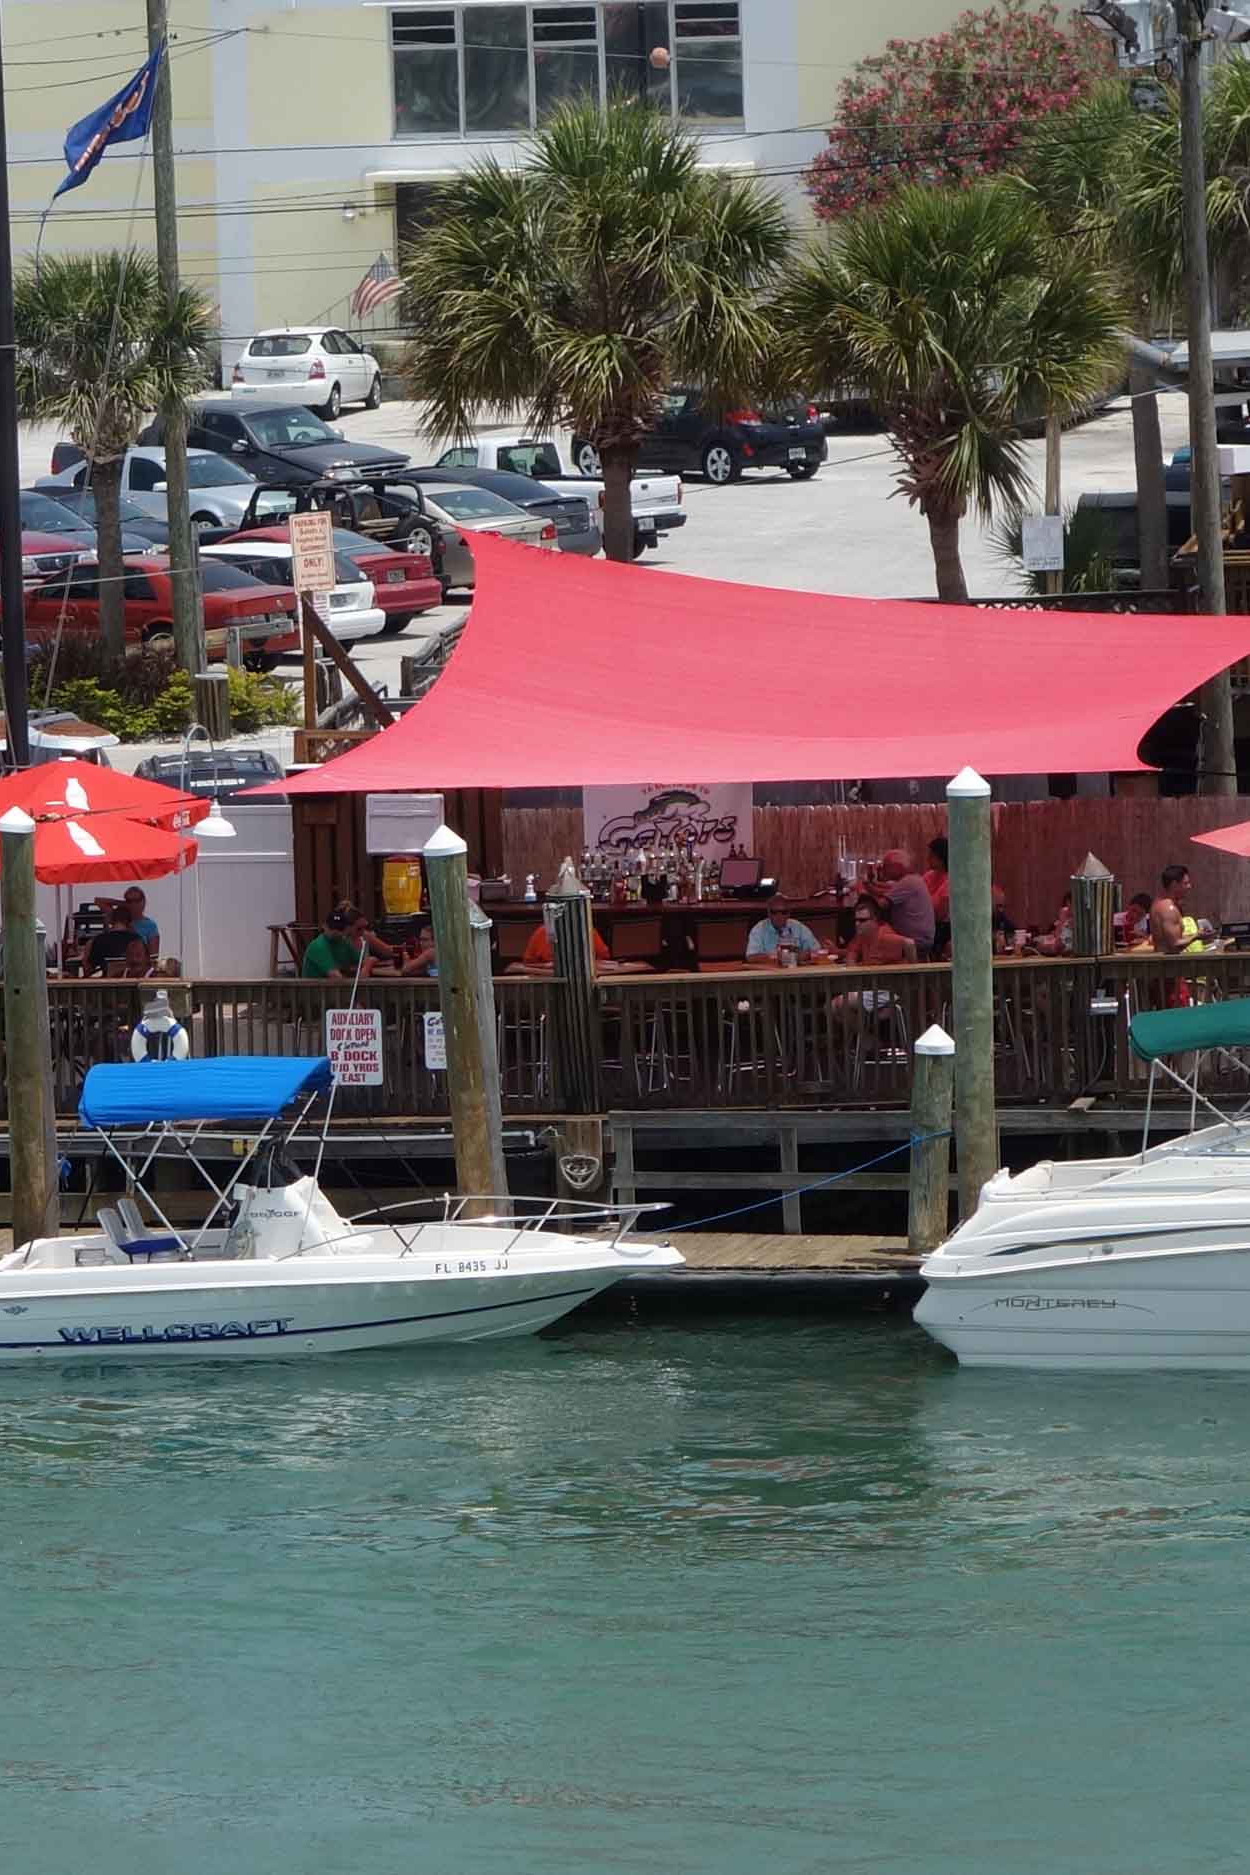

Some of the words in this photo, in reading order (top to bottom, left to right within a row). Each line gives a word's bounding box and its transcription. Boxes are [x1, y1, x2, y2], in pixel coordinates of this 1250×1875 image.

[332, 1012, 374, 1026] AUXLIARY
[354, 1028, 377, 1041] OPEN
[331, 1050, 339, 1061] B
[344, 1050, 378, 1061] DOCK
[354, 1063, 379, 1073] YRDS
[342, 1073, 366, 1083] EAST
[435, 1263, 452, 1274] FL
[458, 1260, 487, 1273] 8435
[494, 1258, 509, 1271] JJ
[992, 1294, 1118, 1312] MONTEREY
[57, 1317, 295, 1344] WELLCRAFT
